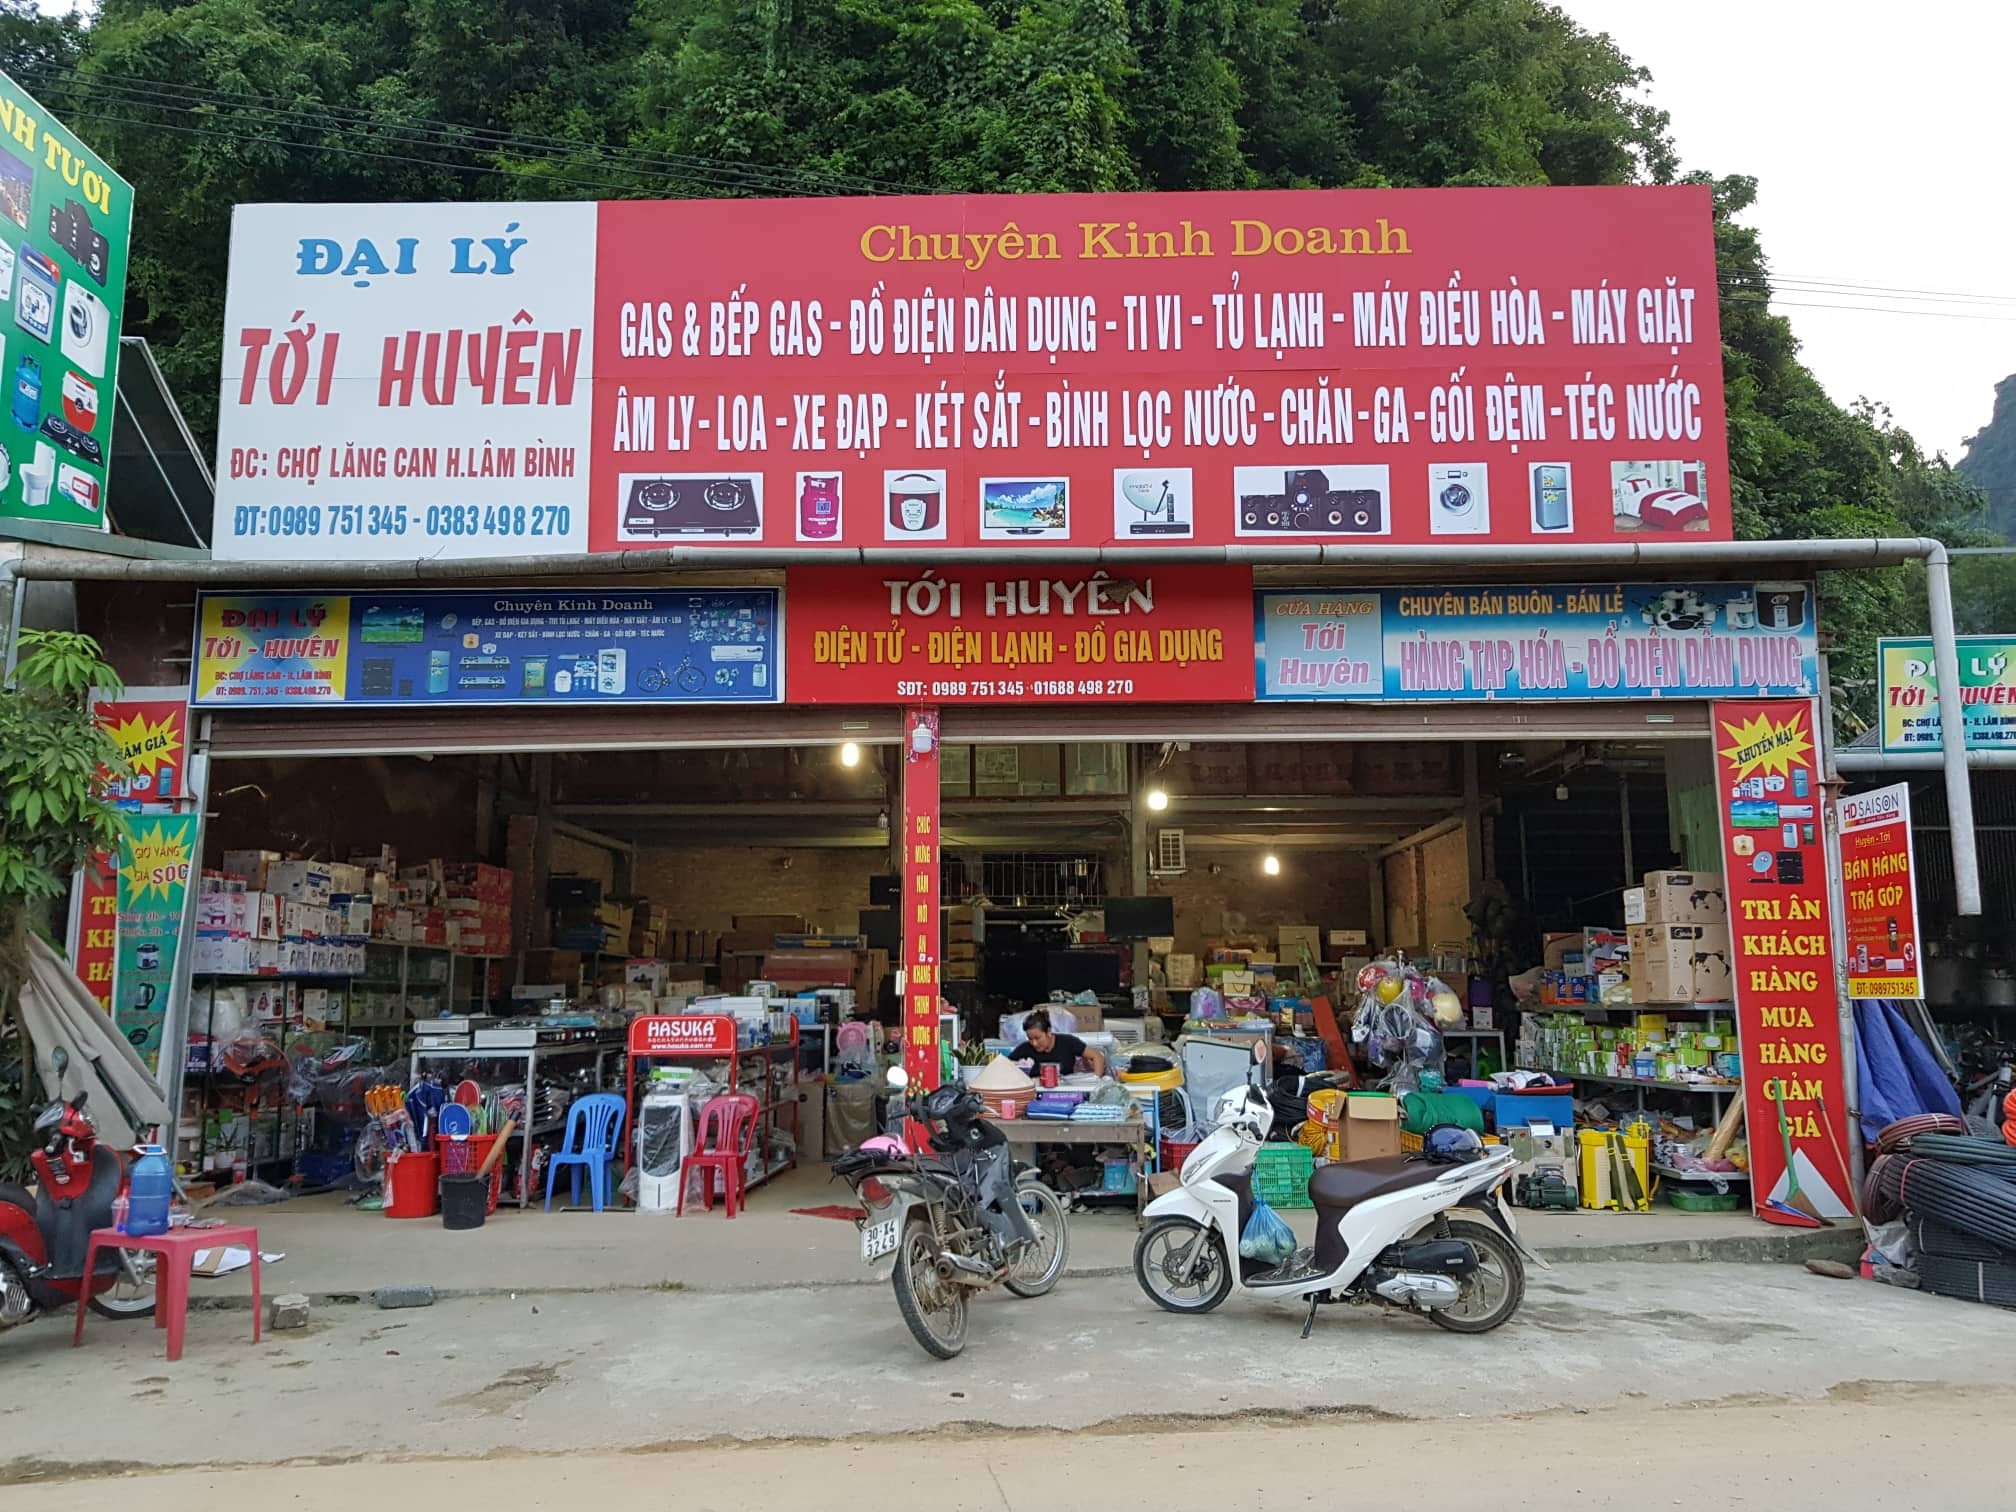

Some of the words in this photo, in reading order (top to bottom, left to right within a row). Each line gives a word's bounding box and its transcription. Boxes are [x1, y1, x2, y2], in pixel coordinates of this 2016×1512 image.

[43, 131, 111, 215] TƯƠI
[296, 238, 418, 288] ĐẠI
[450, 222, 527, 275] LÝ
[860, 222, 1061, 270] Chuyên
[1079, 219, 1214, 260] Kinh
[1231, 218, 1412, 256] Doanh
[620, 302, 673, 358] GAS
[681, 303, 700, 357] &
[709, 284, 760, 357] BẾP
[769, 301, 823, 357] GAS
[849, 281, 884, 356] ĐỒ
[893, 287, 955, 364] ĐIỆN
[964, 286, 1016, 353] DÂN
[1027, 296, 1097, 363] DỤNG
[1124, 296, 1147, 351] TI
[1156, 295, 1183, 351] VI
[1212, 271, 1244, 350] TỦ
[1254, 292, 1325, 360] LẠNH
[1353, 279, 1409, 347] MÁY
[1419, 270, 1480, 347] ĐIỀU
[1491, 276, 1545, 345] HÒA
[1571, 278, 1628, 344] MÁY
[1637, 276, 1695, 355] GIẶT
[239, 310, 340, 405] TỚI
[378, 308, 581, 407] HUYÊN
[613, 386, 655, 453] ÂM
[667, 394, 696, 452] LY
[717, 394, 768, 452] LOA
[792, 393, 826, 451] XE
[837, 393, 888, 459] ĐẠP
[915, 380, 965, 449] KÉT
[972, 369, 1022, 449] SẮT
[1046, 380, 1108, 448] BÌNH
[1122, 390, 1172, 459] LỌC
[1184, 376, 1257, 448] NƯỚC
[1280, 376, 1354, 446] CHĂN
[1373, 387, 1410, 444] GA
[1430, 365, 1475, 443] GỐI
[1486, 372, 1546, 454] ĐỆM
[1564, 371, 1616, 441] TÉC
[1626, 365, 1701, 441] NƯỚC
[230, 447, 267, 479] ĐC:
[277, 445, 322, 486] CHỢ
[329, 441, 387, 478] LĂNG
[393, 447, 437, 477] CAN
[446, 441, 515, 477] H.LÂM
[524, 440, 575, 477] BÌNH
[426, 505, 479, 535] 0383
[484, 505, 526, 535] 498
[531, 505, 570, 535] 270
[494, 599, 552, 613] Chuyên
[558, 599, 597, 611] Kinh
[602, 599, 653, 610] Doanh
[883, 569, 962, 618] TỚI
[985, 570, 1155, 617] HUYÊN
[1317, 599, 1374, 616] HÀNG
[1400, 592, 1466, 617] CHUYÊN
[1469, 590, 1502, 616] BÁN
[1507, 589, 1553, 614] BUÔN
[1567, 588, 1601, 614] BÁN
[1605, 585, 1624, 613] LẺ
[221, 607, 280, 633] ĐẠI
[289, 603, 326, 628] LÝ
[203, 635, 241, 659] TỚI
[264, 635, 340, 659] HUYÊN
[814, 625, 868, 669] ĐIỆN
[873, 619, 906, 664] TỬ
[927, 626, 982, 670] ĐIỆN
[991, 631, 1053, 669] LẠNH
[1074, 620, 1107, 664] ĐỒ
[1113, 630, 1154, 663] GIA
[1159, 628, 1223, 668] DỤNG
[1301, 622, 1346, 651] Tới
[1279, 657, 1370, 688] Huyên
[1400, 630, 1464, 691] HÀNG
[1468, 640, 1515, 699] TẠP
[1519, 627, 1568, 690] HÓA
[1624, 627, 1680, 697] ĐIỆN
[1685, 628, 1733, 688] DÂN
[1738, 636, 1803, 696] DỤNG
[1971, 652, 2007, 676] LÝ
[897, 681, 928, 696] SĐT:
[932, 681, 967, 696] 0989
[971, 681, 995, 695] 751
[998, 681, 1024, 695] 345
[1034, 680, 1075, 695] 01688
[1078, 680, 1103, 694] 498
[1107, 679, 1133, 694] 270
[1889, 685, 1926, 707] TỚI
[145, 730, 167, 751] GIÁ
[1737, 732, 1776, 766] KHUYẾN
[1774, 727, 1794, 749] MẠI
[1844, 856, 1870, 881] BÁN
[1872, 852, 1908, 877] HÀNG
[90, 896, 116, 915] TR
[1741, 900, 1780, 920] TRI
[1788, 894, 1820, 920] ÂN
[1850, 882, 1875, 911] TRẢ
[1878, 881, 1904, 908] GÓP
[1743, 930, 1825, 956] KHÁCH
[1750, 965, 1818, 992] HÀNG
[648, 1020, 714, 1037] HASUKA
[1760, 1007, 1814, 1028] MUA
[1760, 1037, 1827, 1064] HÀNG
[1763, 1072, 1824, 1101] GIẢM
[1778, 1110, 1821, 1138] GIÁ
